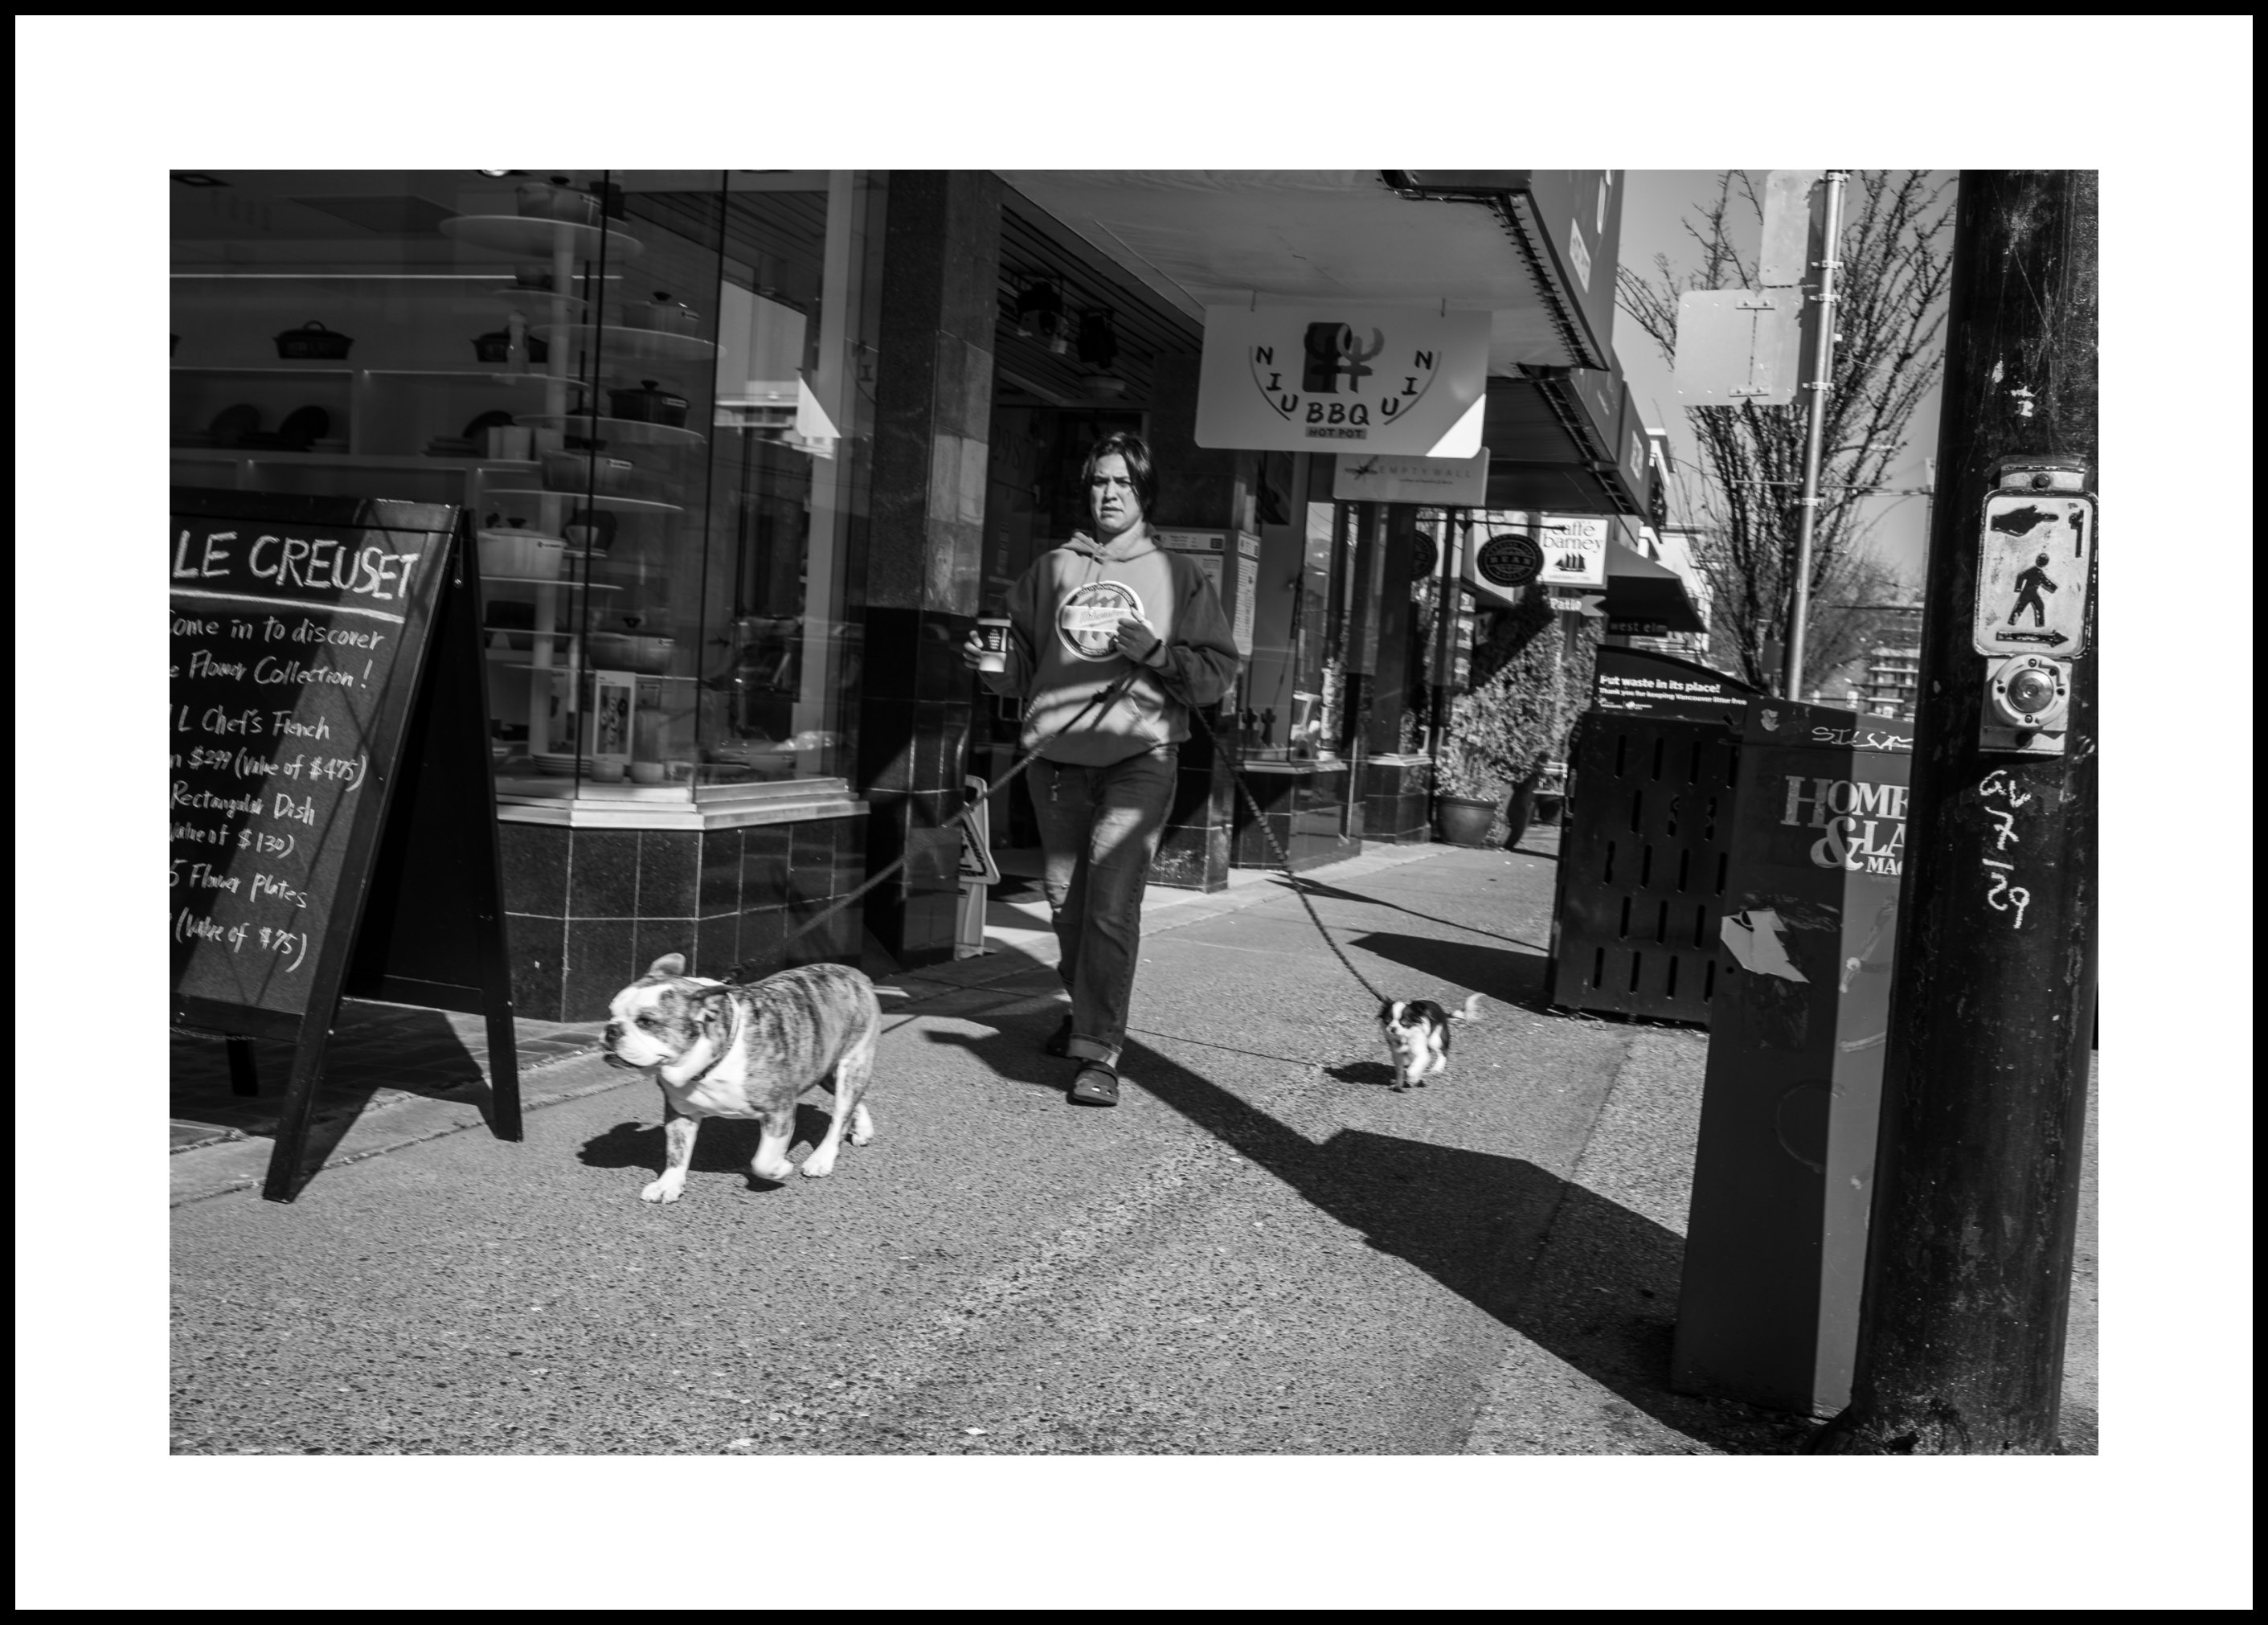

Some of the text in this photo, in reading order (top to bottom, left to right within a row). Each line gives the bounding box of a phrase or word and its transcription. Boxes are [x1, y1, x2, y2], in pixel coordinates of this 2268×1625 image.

[1305, 401, 1370, 426] BBQ
[1308, 428, 1364, 439] HOT POT
[1543, 532, 1603, 554] barney
[172, 530, 421, 600] LE CREUSET
[230, 618, 254, 641] in
[262, 616, 285, 643] to
[292, 617, 386, 650] discover
[1610, 622, 1668, 633] west elm
[189, 649, 248, 682] Flower
[1599, 675, 1721, 693] Put waste in its place!
[1599, 687, 1621, 695] Thank
[1646, 691, 1675, 701] keeping
[1675, 694, 1713, 702] Vancouver
[283, 754, 306, 780] of
[273, 792, 316, 827] Dish
[208, 823, 231, 846] of
[227, 922, 251, 953] of
